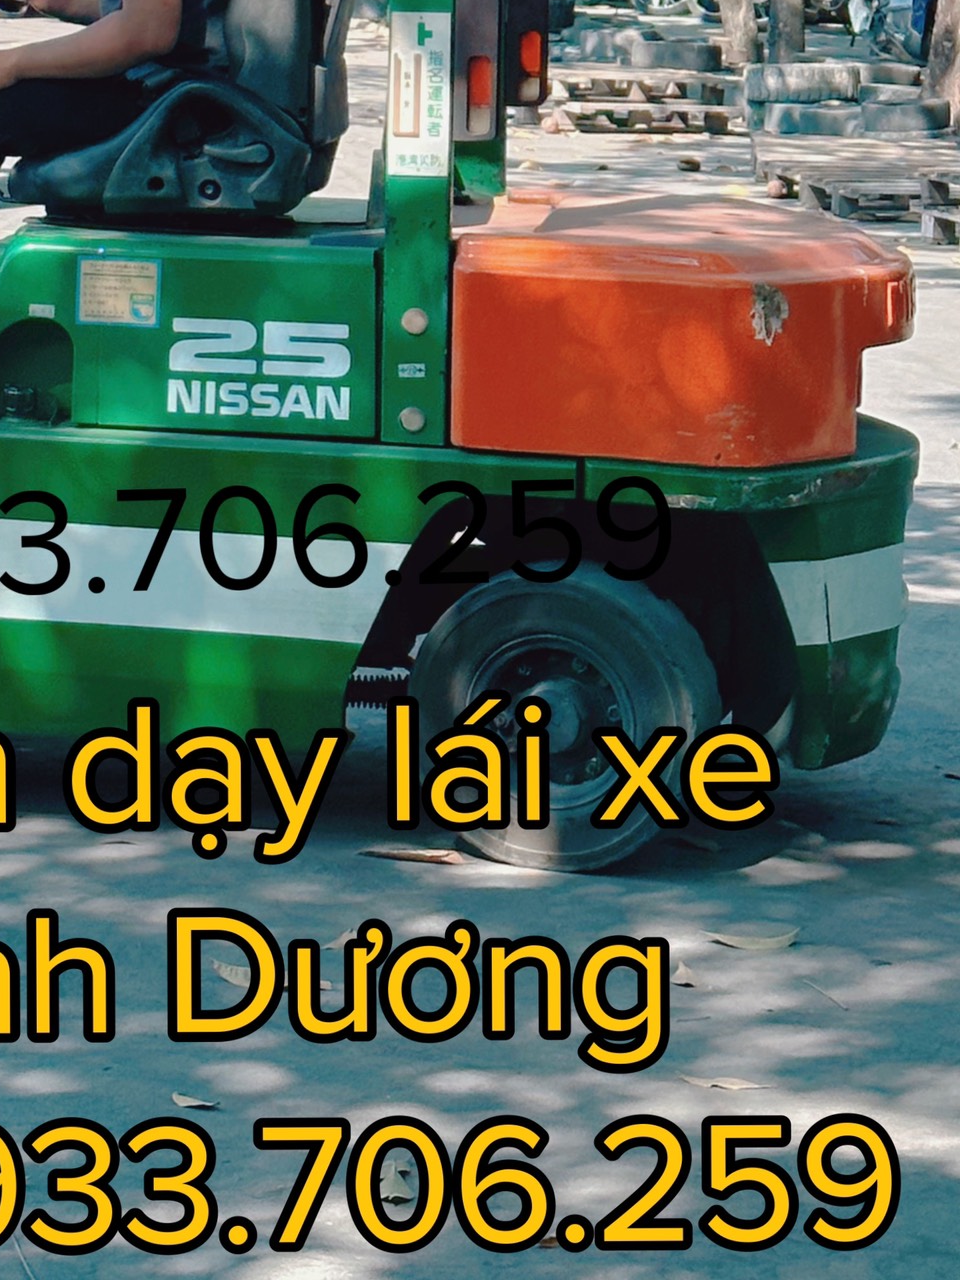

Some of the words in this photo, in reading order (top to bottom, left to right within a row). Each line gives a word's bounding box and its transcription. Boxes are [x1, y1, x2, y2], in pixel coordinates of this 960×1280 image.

[426, 50, 444, 138] 指名運転者
[167, 317, 352, 380] 25
[166, 379, 351, 421] NISSAN
